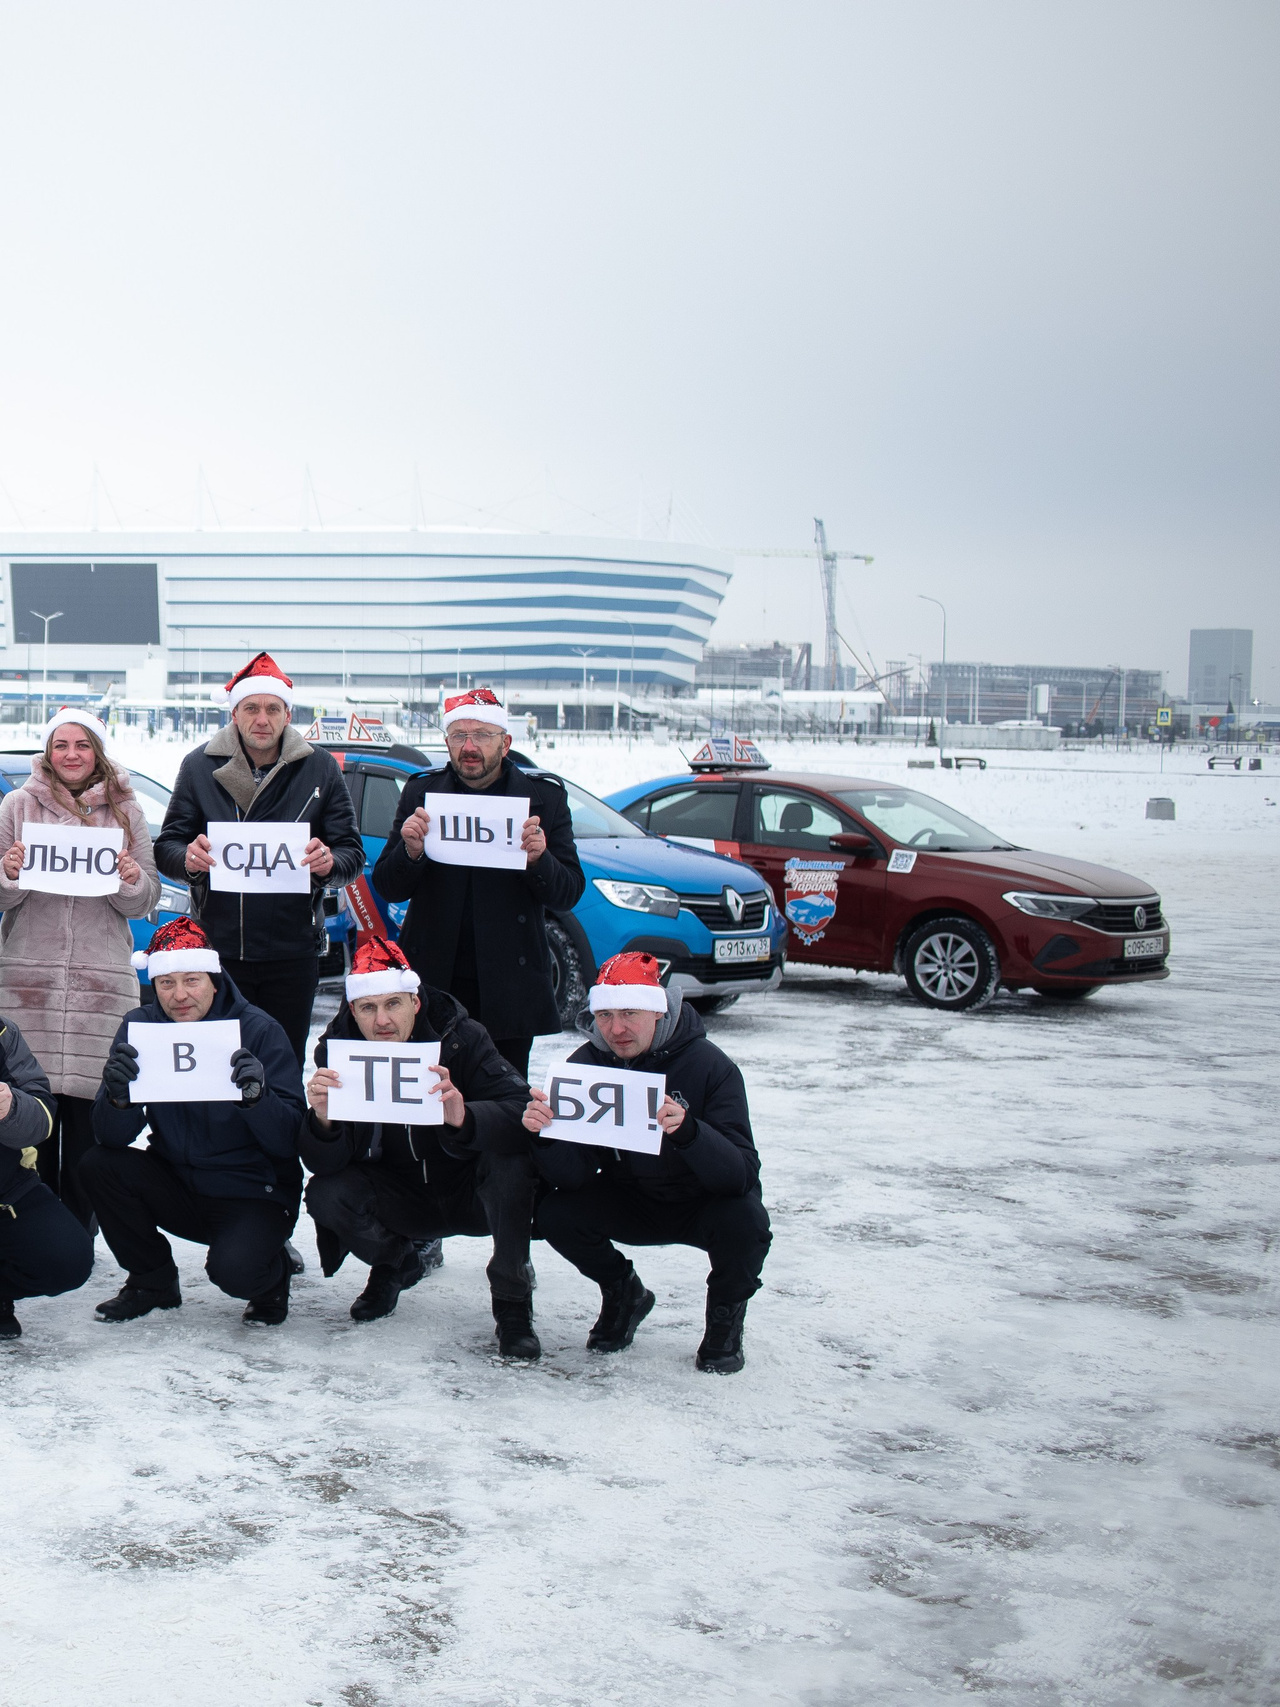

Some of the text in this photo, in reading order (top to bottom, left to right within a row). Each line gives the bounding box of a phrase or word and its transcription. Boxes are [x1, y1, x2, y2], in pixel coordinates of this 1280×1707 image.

[323, 731, 392, 743] 773 055
[353, 725, 361, 739] У
[22, 844, 118, 876] ЛЬНО
[222, 843, 296, 877] СДА
[351, 882, 375, 930] АРАНТ.РФ
[173, 1042, 197, 1072] В
[349, 1055, 423, 1105] ТЕ
